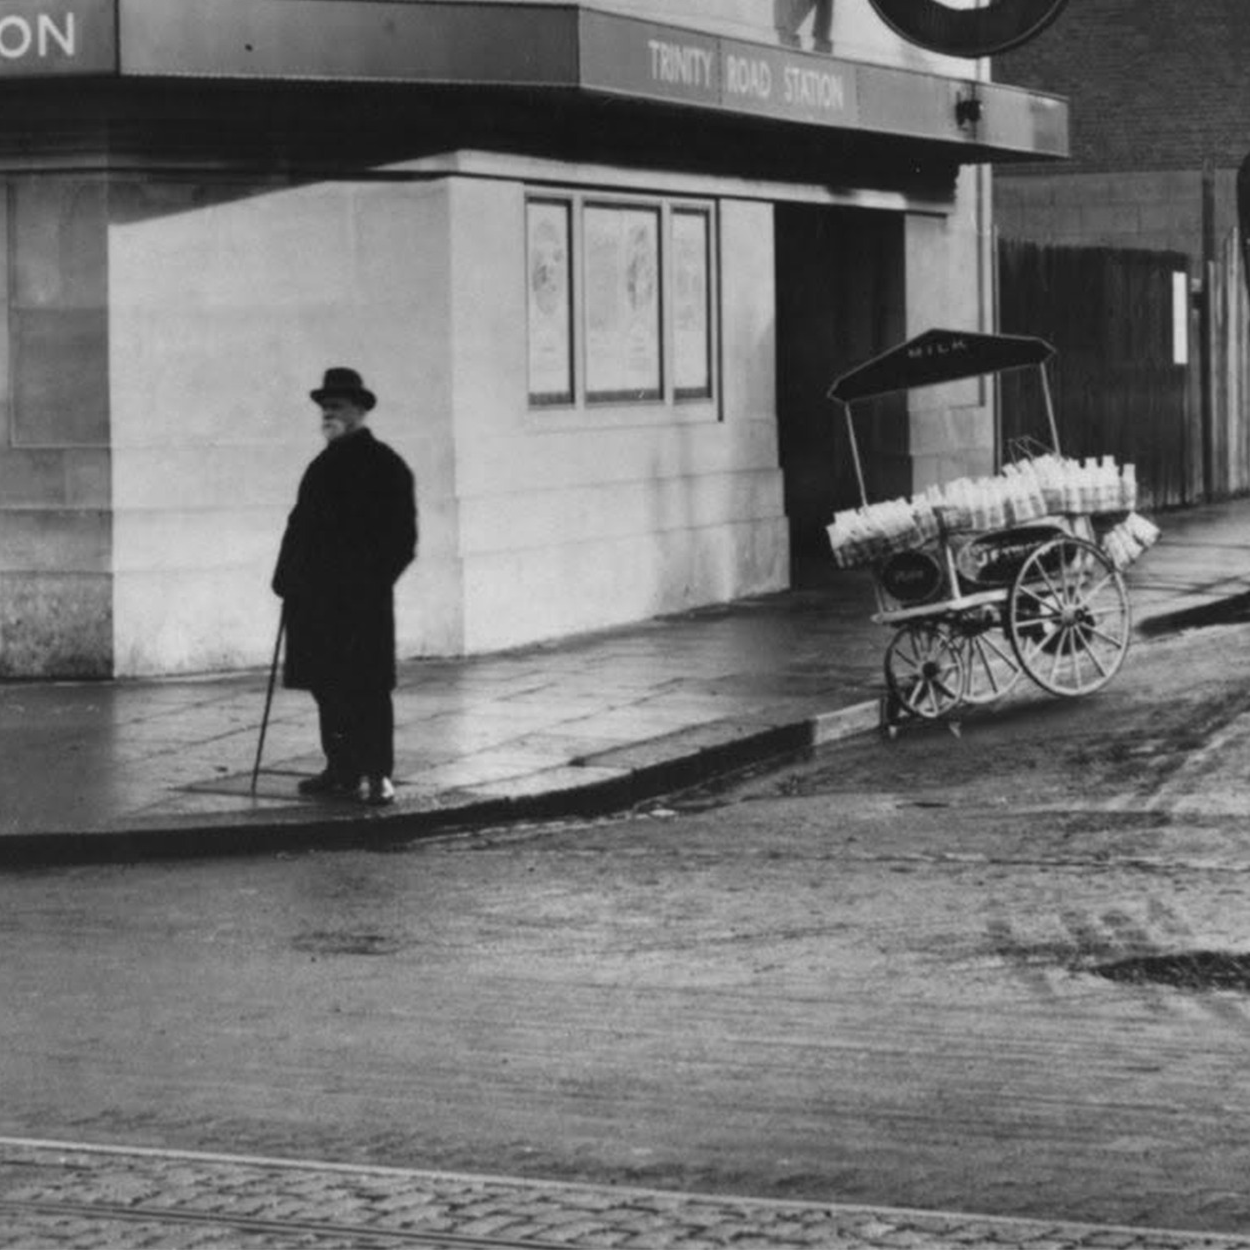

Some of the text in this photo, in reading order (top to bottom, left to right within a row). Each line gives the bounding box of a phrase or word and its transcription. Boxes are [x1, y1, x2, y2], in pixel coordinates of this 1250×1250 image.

[649, 39, 845, 110] TRINITY ROAD STATION
